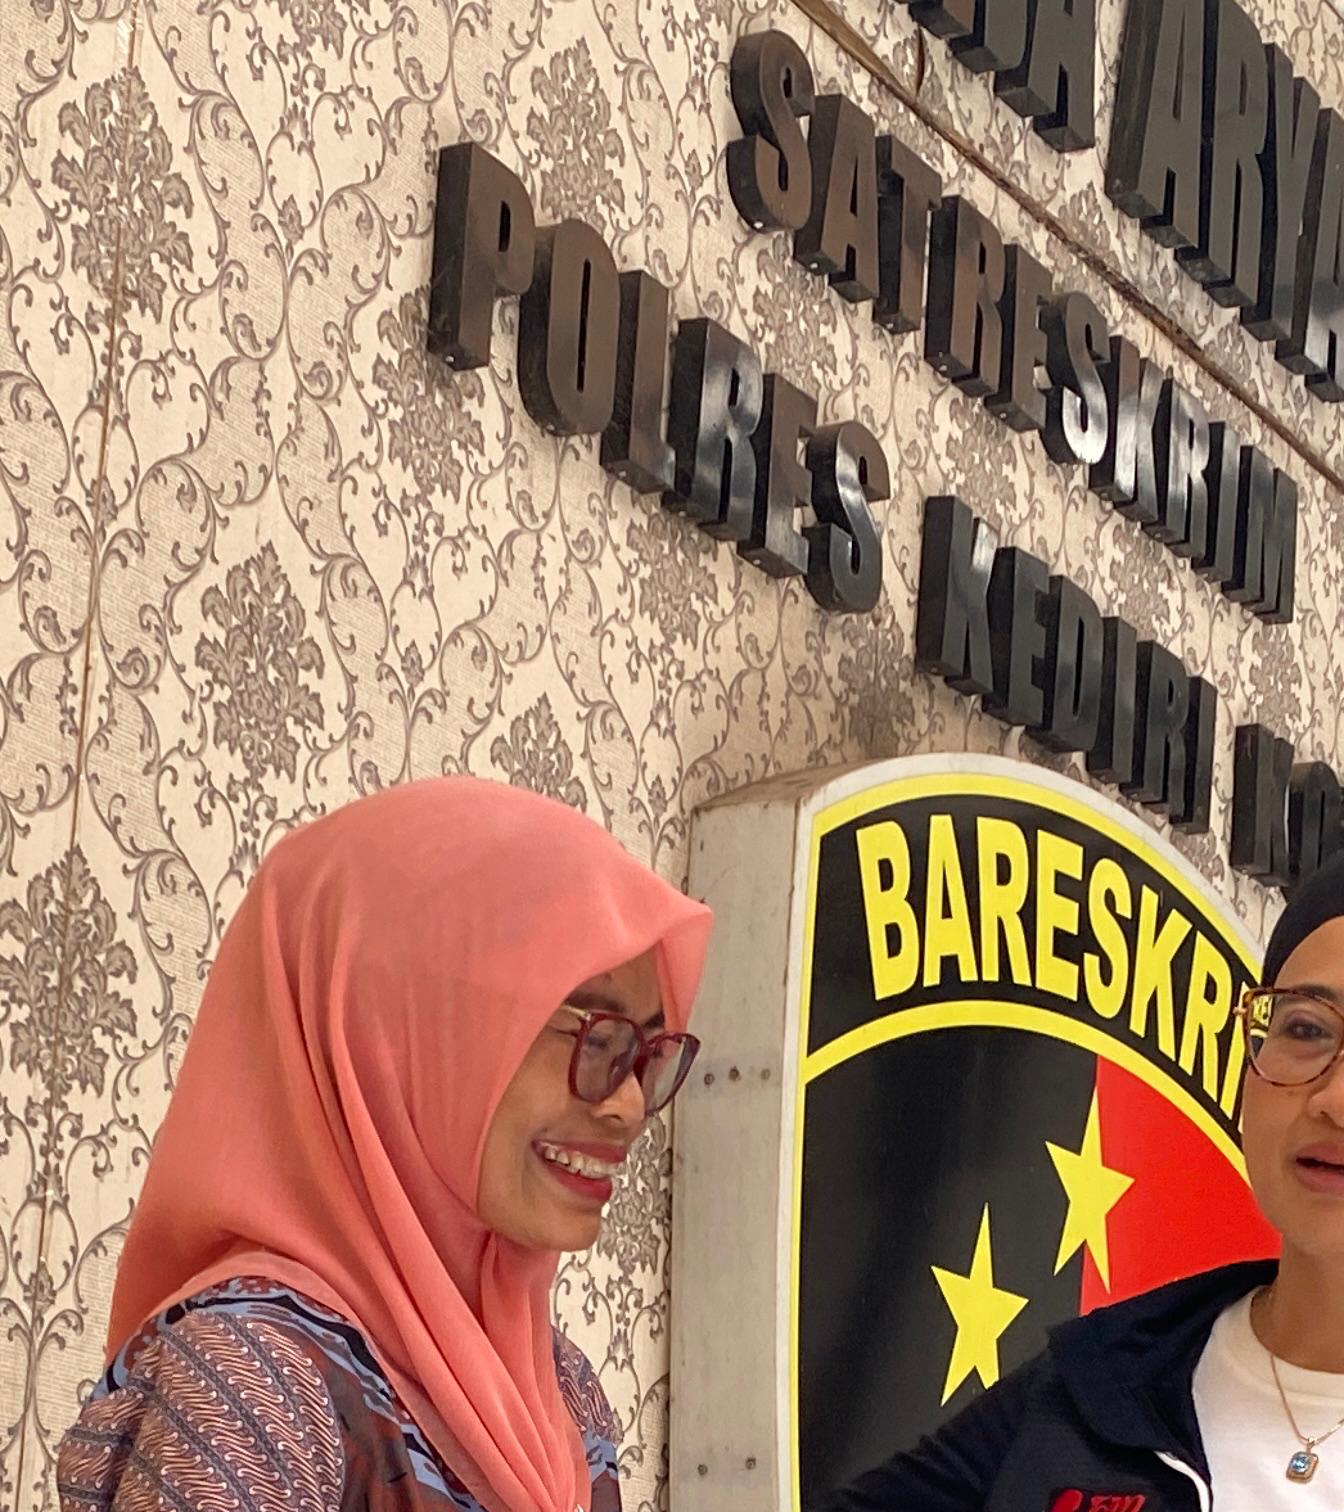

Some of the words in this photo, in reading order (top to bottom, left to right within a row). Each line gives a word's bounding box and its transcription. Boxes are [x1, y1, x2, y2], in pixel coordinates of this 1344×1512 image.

[426, 141, 891, 616] POLRES
[915, 494, 1218, 835] KEDIRI
[726, 28, 1298, 626] SATRESKRIM
